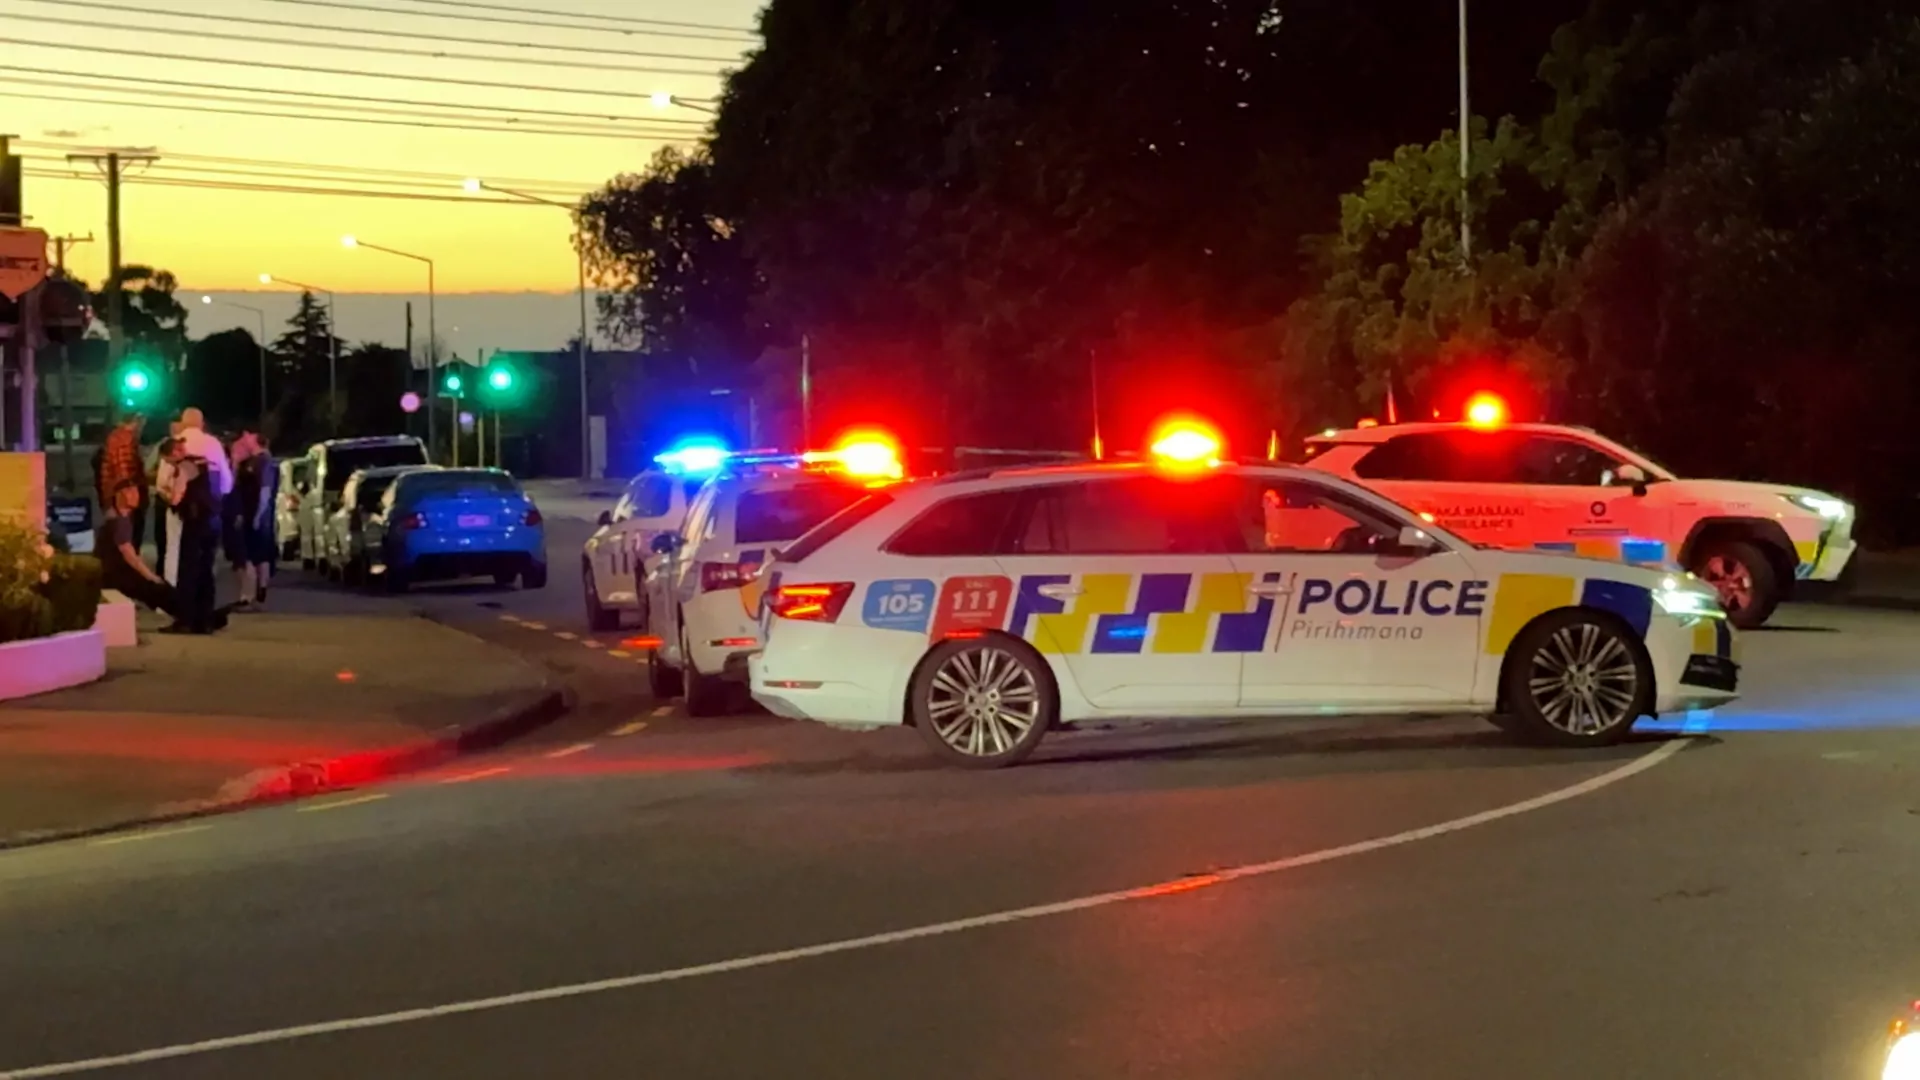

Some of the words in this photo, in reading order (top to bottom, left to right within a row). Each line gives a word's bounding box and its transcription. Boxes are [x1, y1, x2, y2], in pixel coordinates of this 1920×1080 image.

[878, 594, 925, 616] 105
[952, 591, 998, 611] 111
[1297, 579, 1489, 616] POLICE
[1290, 620, 1423, 640] Pirihimana
